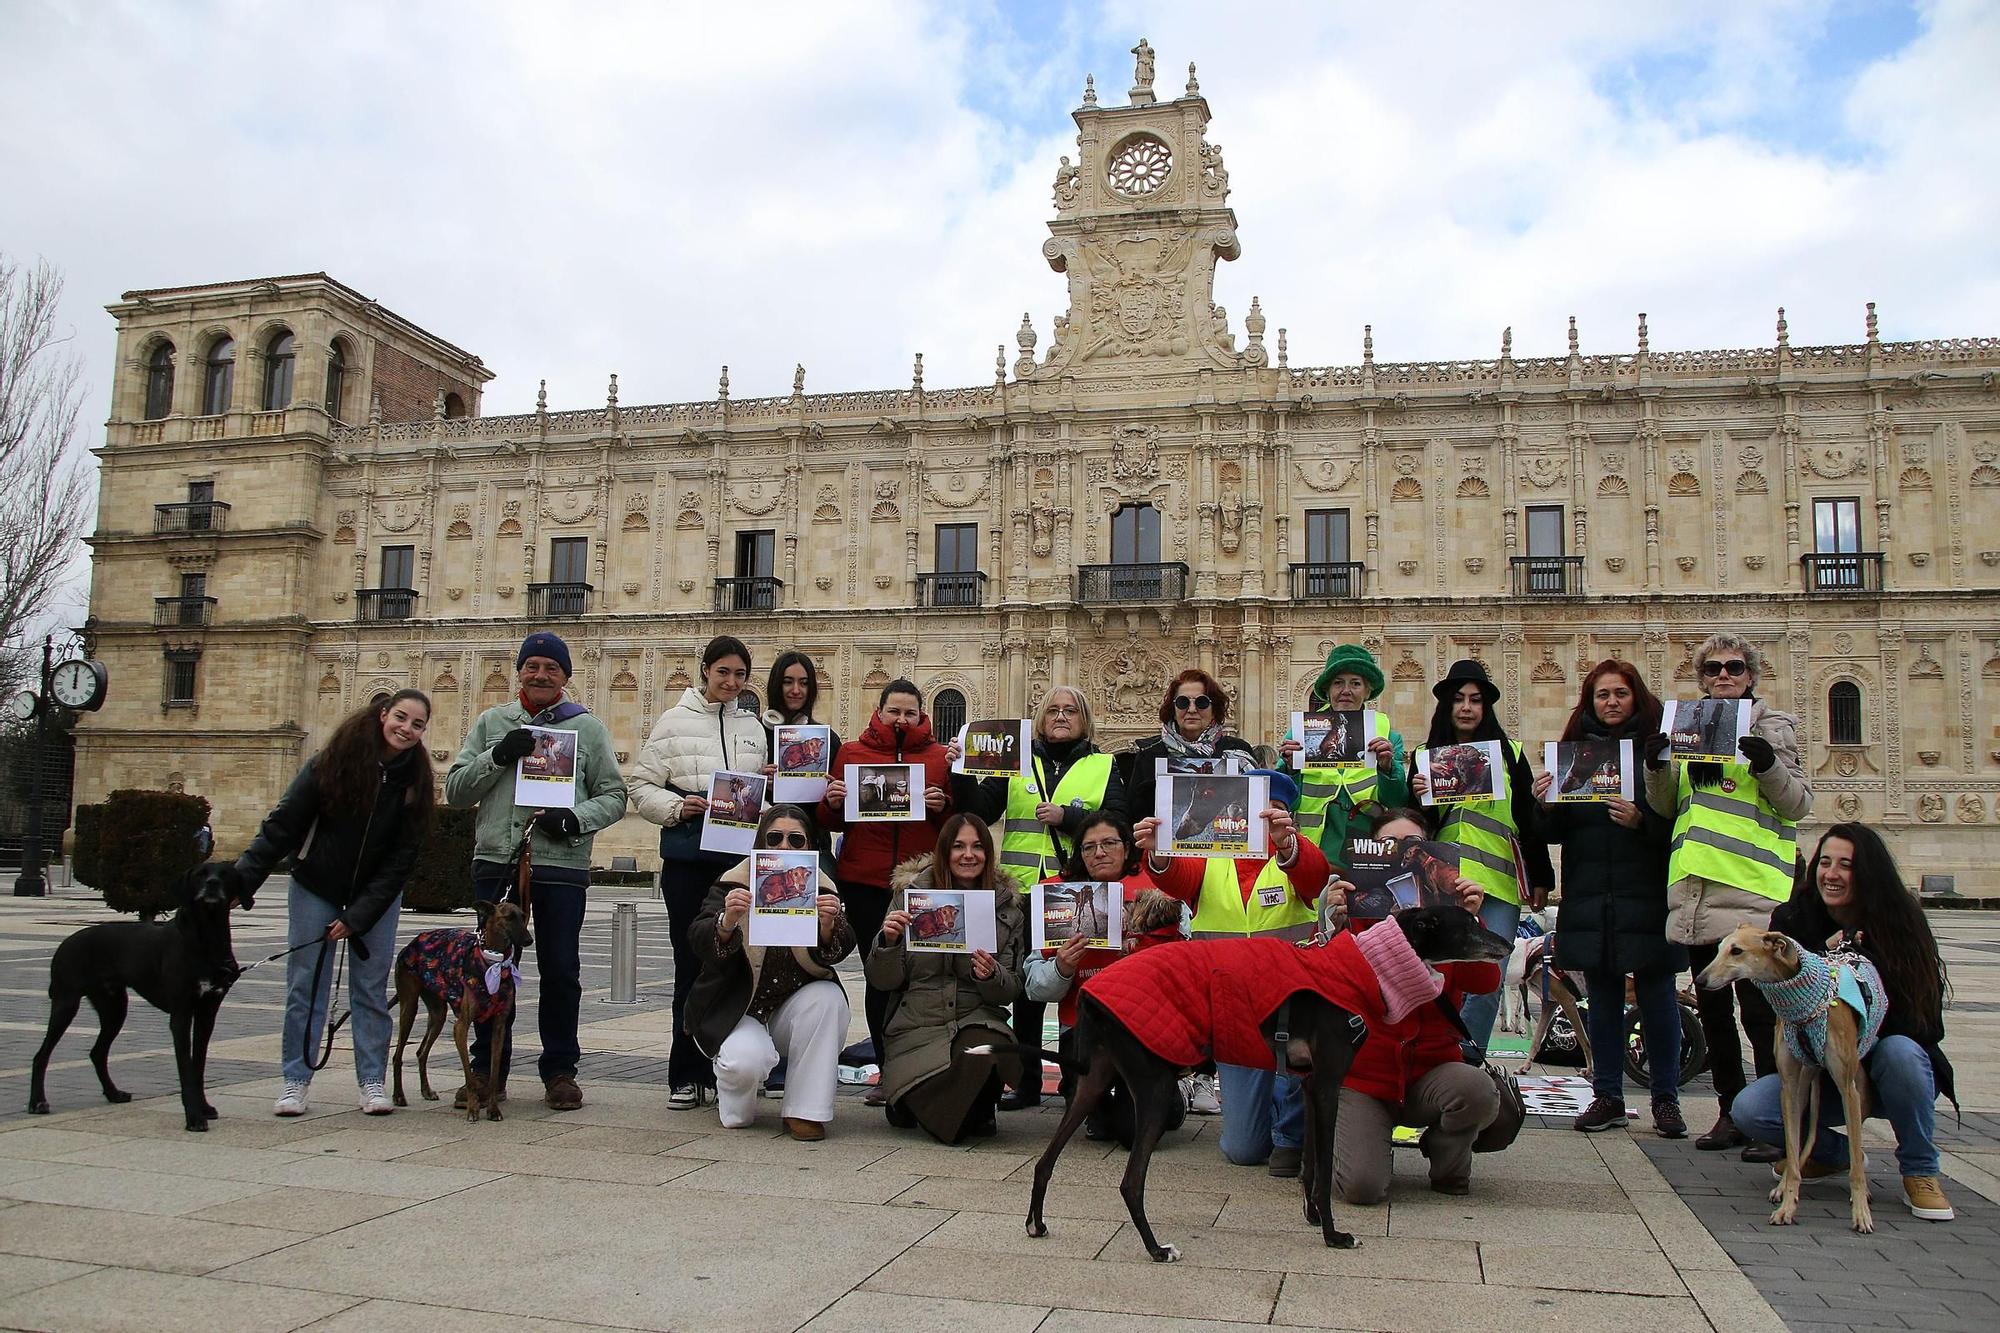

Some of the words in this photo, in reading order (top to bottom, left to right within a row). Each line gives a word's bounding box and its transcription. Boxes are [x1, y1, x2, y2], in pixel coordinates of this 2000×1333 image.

[1307, 718, 1329, 727] Why?
[1674, 733, 1698, 743] Why?
[972, 734, 1014, 753] Why?
[1434, 777, 1456, 787] Why?
[1596, 774, 1620, 784] Why?
[889, 794, 910, 803] Why?
[714, 800, 734, 809] Why?
[1219, 818, 1247, 830] Why?
[1353, 838, 1394, 857] Why?
[911, 897, 930, 906] Why?
[1047, 909, 1071, 920] Why?
